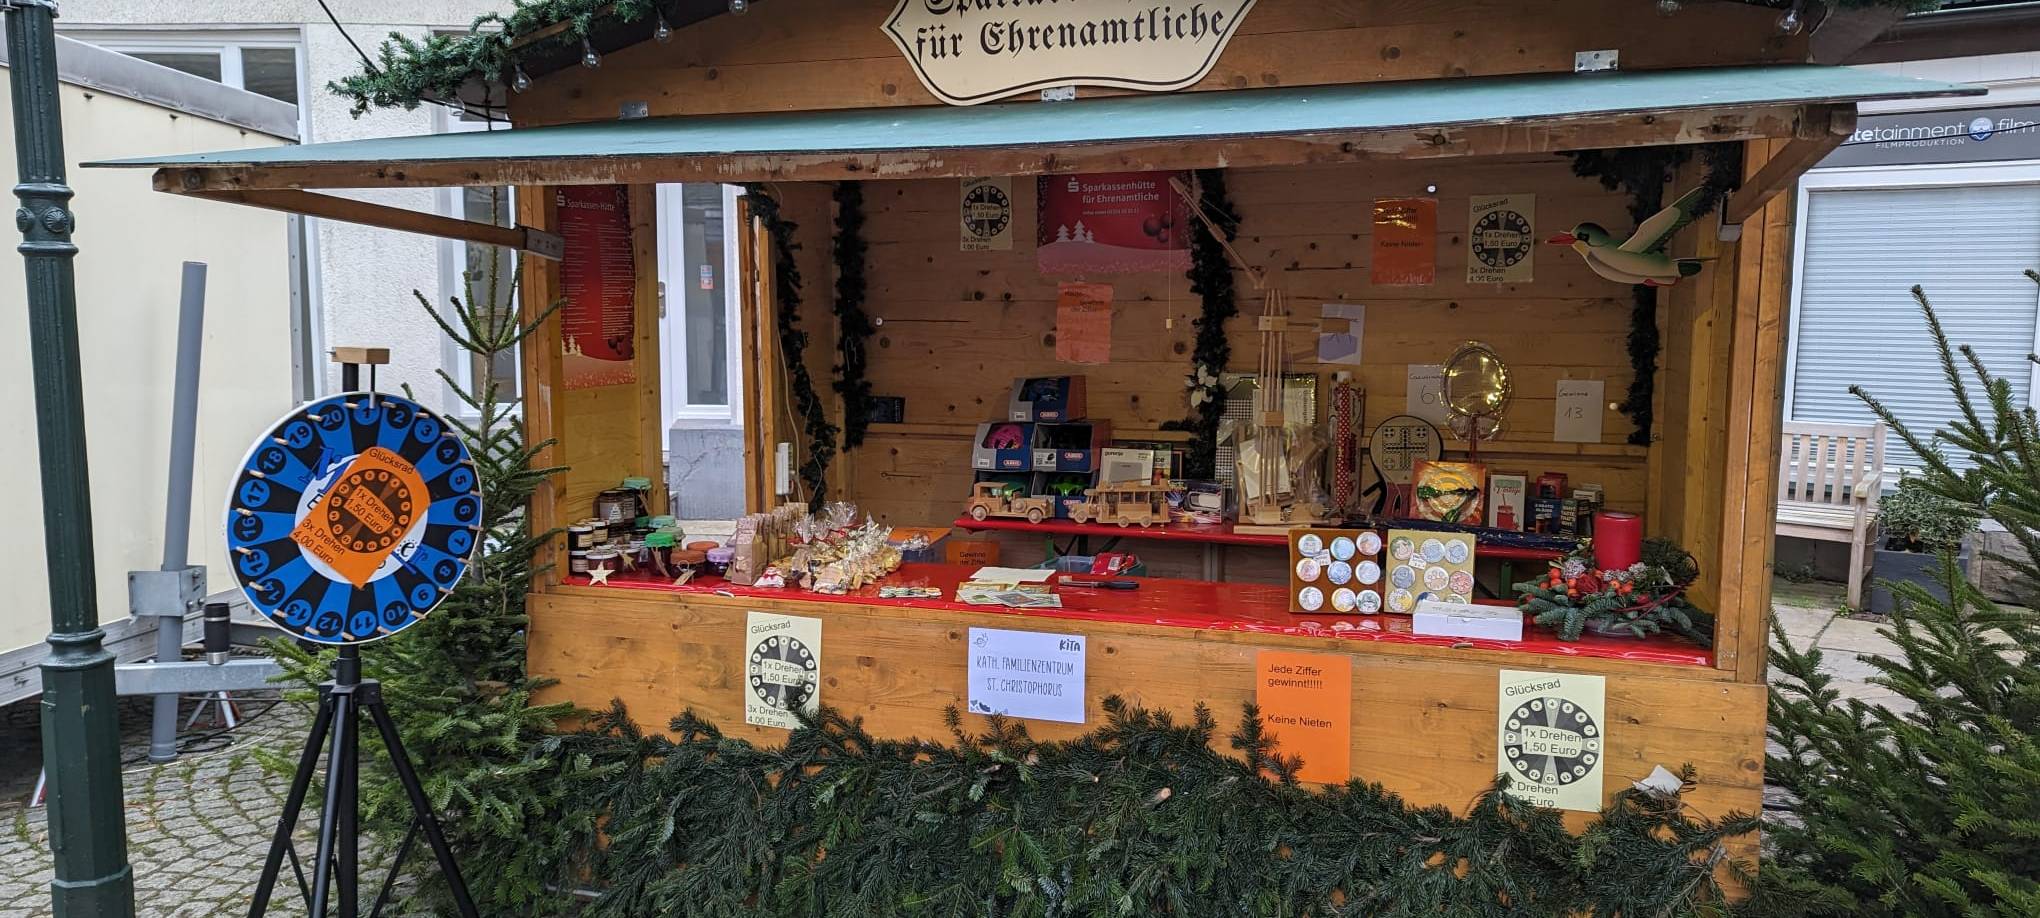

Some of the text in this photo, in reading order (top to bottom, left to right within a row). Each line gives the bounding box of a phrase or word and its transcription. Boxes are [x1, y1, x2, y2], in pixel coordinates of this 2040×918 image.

[916, 3, 1224, 63] für Ehrenamtliche
[1849, 122, 1965, 141] tetainment
[1875, 138, 1965, 148] FILMPRODUKTION
[1082, 181, 1156, 193] Sparkassenhütte
[1082, 192, 1160, 204] für Ehrenamtliche
[1495, 231, 1519, 239] Drehen
[1480, 266, 1506, 274] Drehen
[1421, 384, 1435, 404] 6
[322, 410, 341, 427] 20
[394, 411, 405, 422] 2
[1564, 406, 1584, 420] 13
[288, 425, 310, 444] 19
[421, 425, 432, 436] 3
[264, 450, 283, 470] 18
[442, 448, 455, 458] 4
[368, 448, 415, 475] Glücksrad
[455, 474, 467, 485] 5
[247, 482, 264, 502] 17
[355, 488, 395, 525] 1x Drehen
[460, 504, 470, 514] 6
[241, 517, 256, 538] 16
[364, 513, 384, 533] Euro
[302, 518, 345, 556] 3x Drehen
[454, 537, 465, 546] 7
[293, 530, 335, 565] 4.00 Euro
[440, 565, 452, 576] 8
[264, 581, 280, 600] 14
[418, 588, 429, 600] 9
[288, 603, 307, 620] 13
[386, 606, 406, 620] 10
[318, 617, 338, 630] 12
[354, 616, 373, 630] 11
[751, 620, 791, 634] Glücksrad
[764, 661, 804, 674] 1x Drehen
[976, 655, 1074, 676] KATH. FAMILIENZENTRUM
[1268, 664, 1323, 676] Jede Ziffer
[986, 677, 1063, 697] ST. CHRISTOPHORUS
[1505, 679, 1561, 697] Glücksrad
[747, 705, 788, 717] 3x Drehen
[767, 717, 786, 727] Euro
[1268, 714, 1332, 728] Keine Nieten
[1524, 728, 1536, 738] 1x
[1539, 730, 1581, 743] Drehen
[1524, 742, 1547, 753] 1.50
[1550, 744, 1577, 756] Euro
[1518, 782, 1558, 794] Drehen
[1528, 795, 1554, 808] Euro
